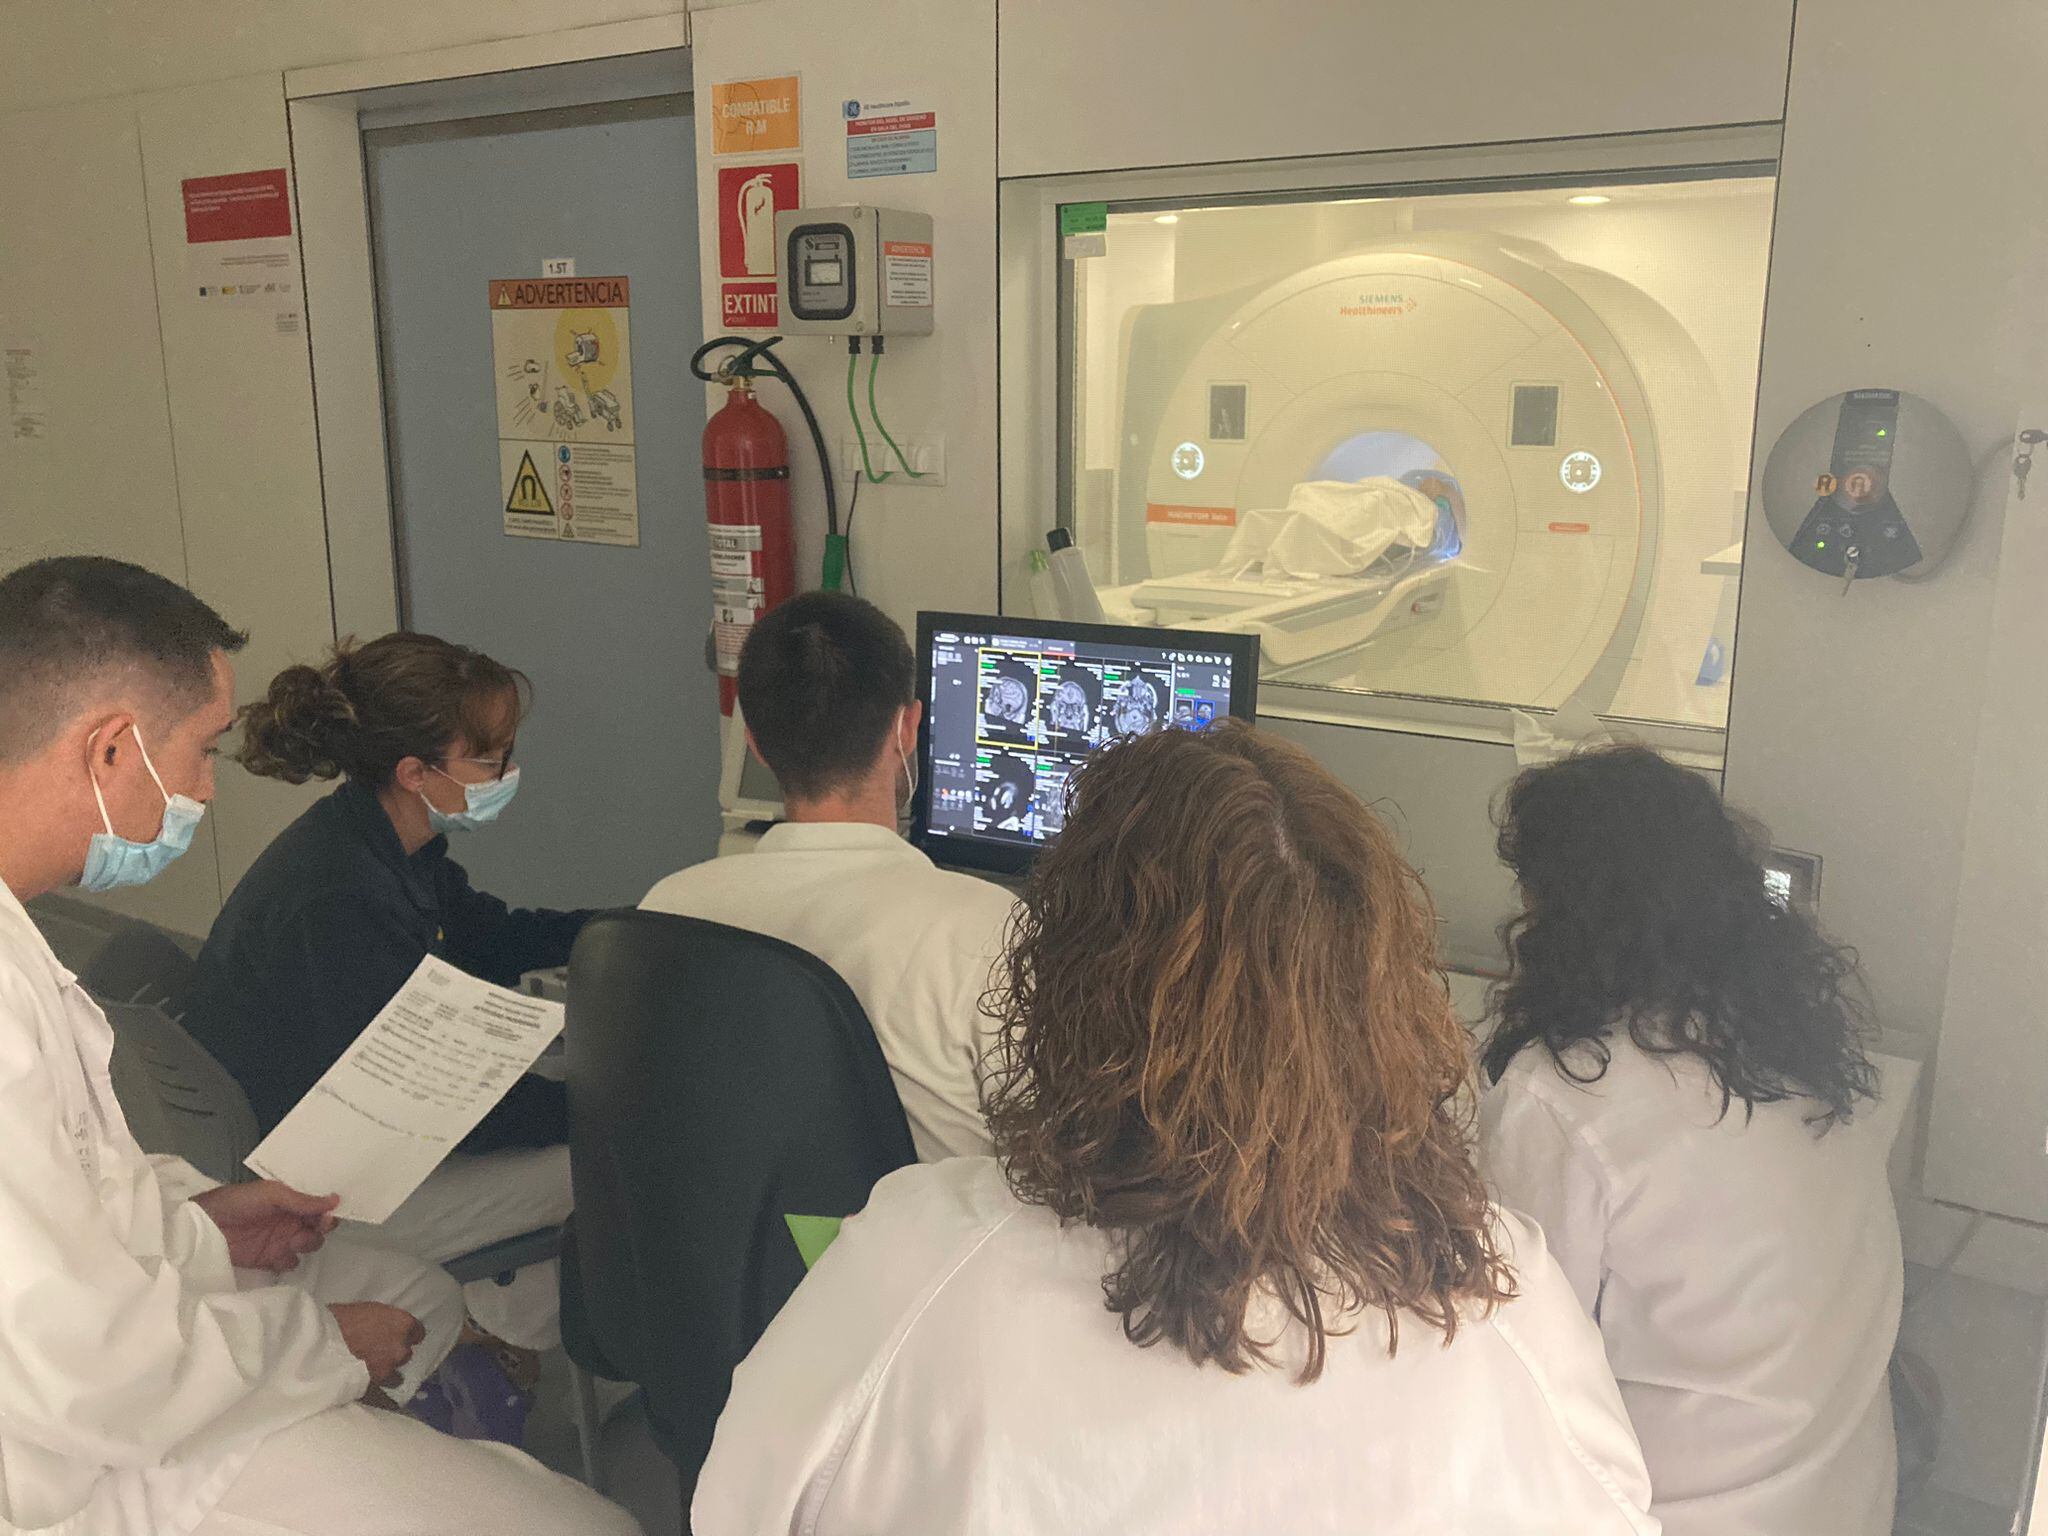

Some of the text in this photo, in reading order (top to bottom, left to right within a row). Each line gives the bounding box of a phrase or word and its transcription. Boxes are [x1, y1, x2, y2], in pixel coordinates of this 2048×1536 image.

[722, 97, 791, 118] COMPATIBLE
[549, 262, 567, 274] 1.5T
[516, 282, 623, 305] ADVERTENCIA
[1359, 295, 1403, 304] SIEMENS
[724, 294, 777, 314] EXTINT
[1340, 306, 1403, 316] Healthineers
